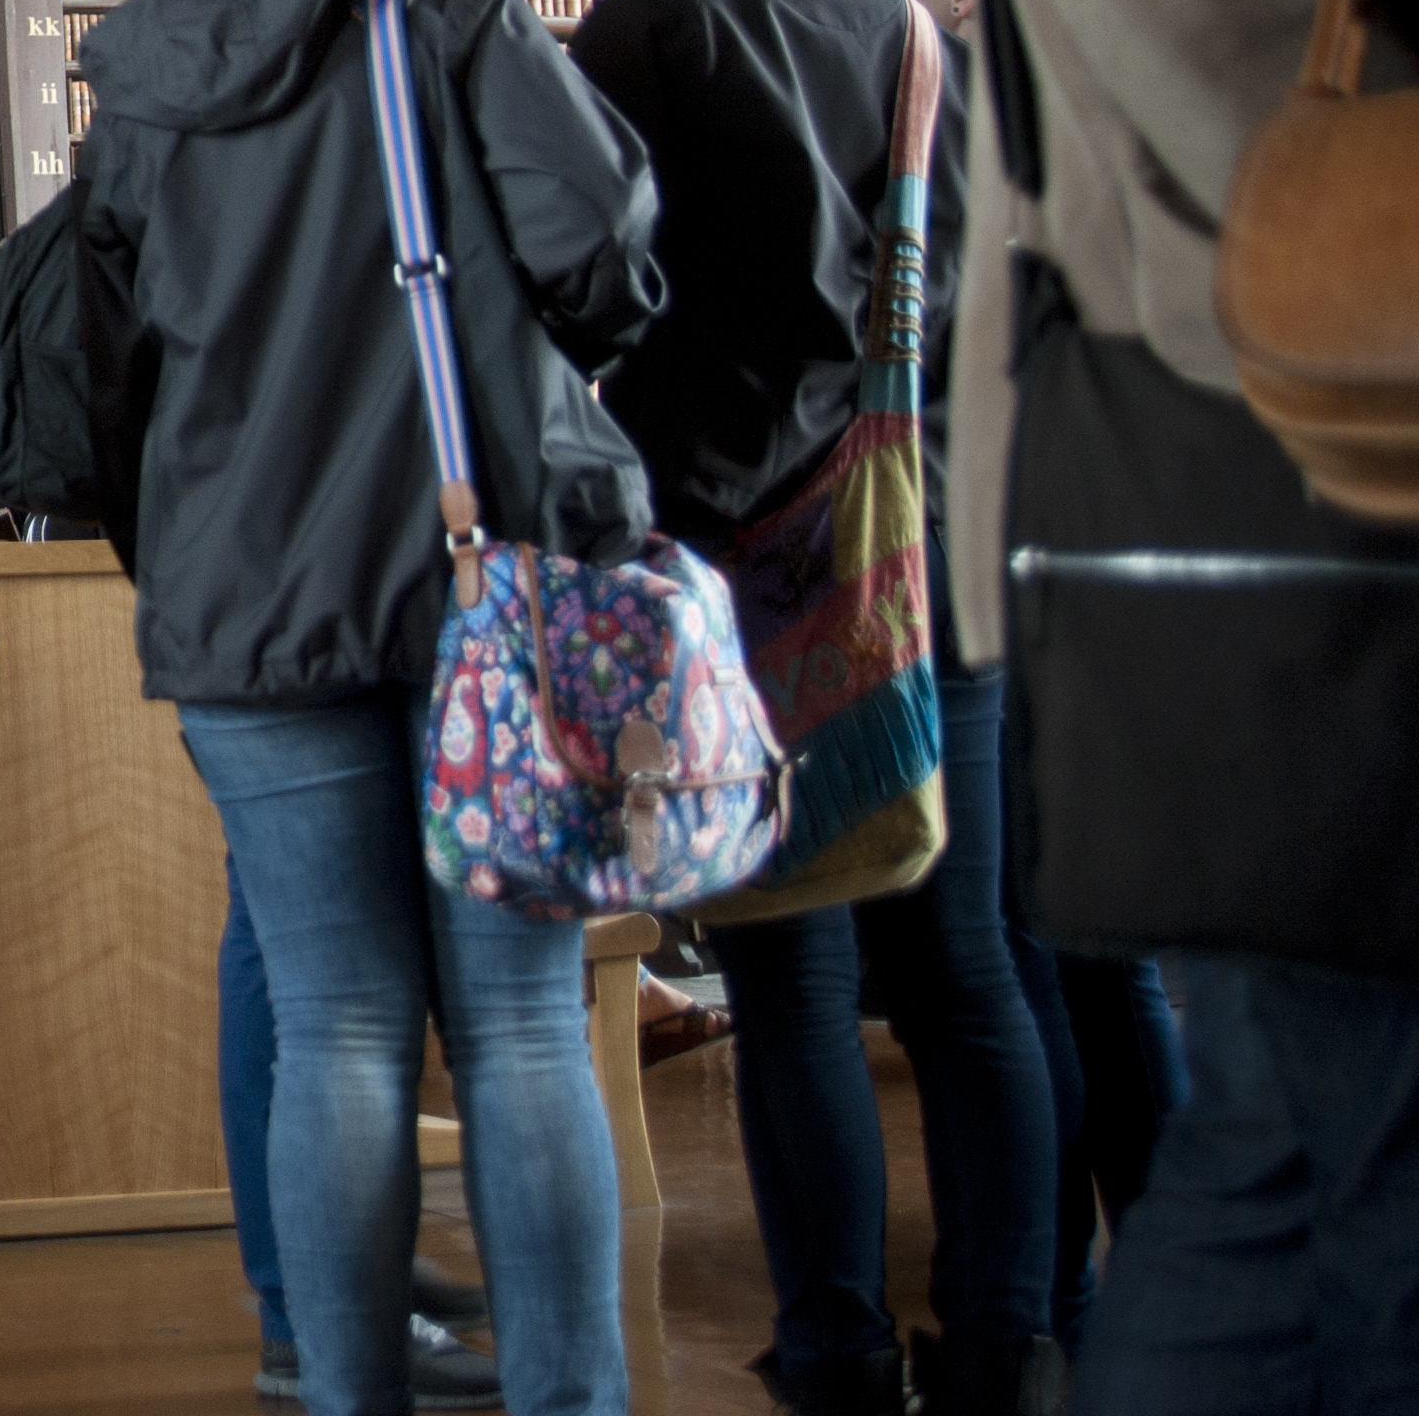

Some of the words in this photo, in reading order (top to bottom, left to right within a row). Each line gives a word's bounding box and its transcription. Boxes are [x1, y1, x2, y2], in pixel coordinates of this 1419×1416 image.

[29, 17, 61, 36] kk
[41, 83, 58, 104] ii
[31, 151, 64, 175] hh
